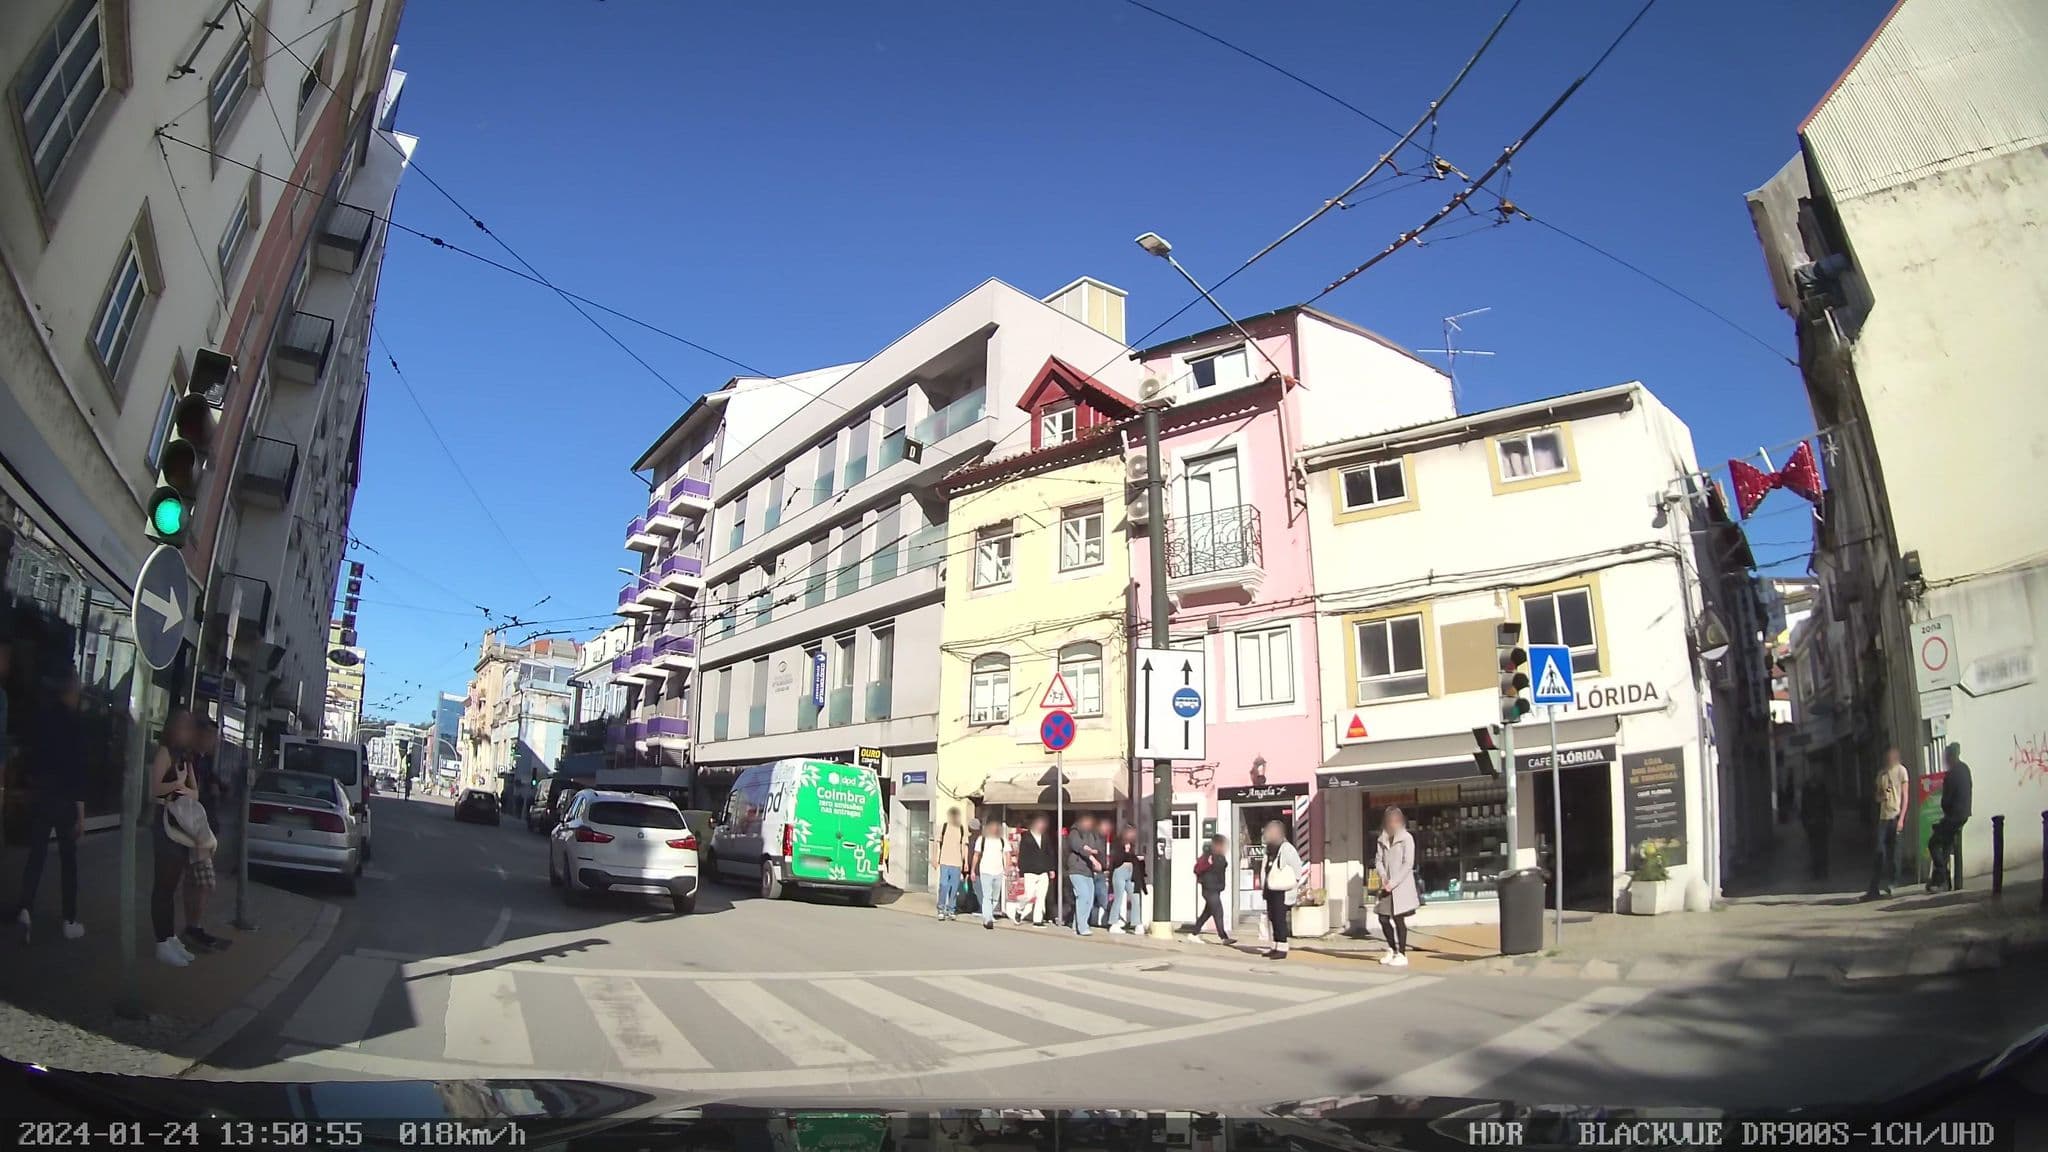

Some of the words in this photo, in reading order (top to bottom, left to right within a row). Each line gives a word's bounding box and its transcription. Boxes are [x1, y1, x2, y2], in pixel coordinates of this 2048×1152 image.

[1921, 622, 1942, 634] zona
[1563, 681, 1658, 712] LÓRIDA
[860, 748, 881, 758] OURO
[841, 776, 857, 786] dpd
[816, 786, 866, 804] Coimbra
